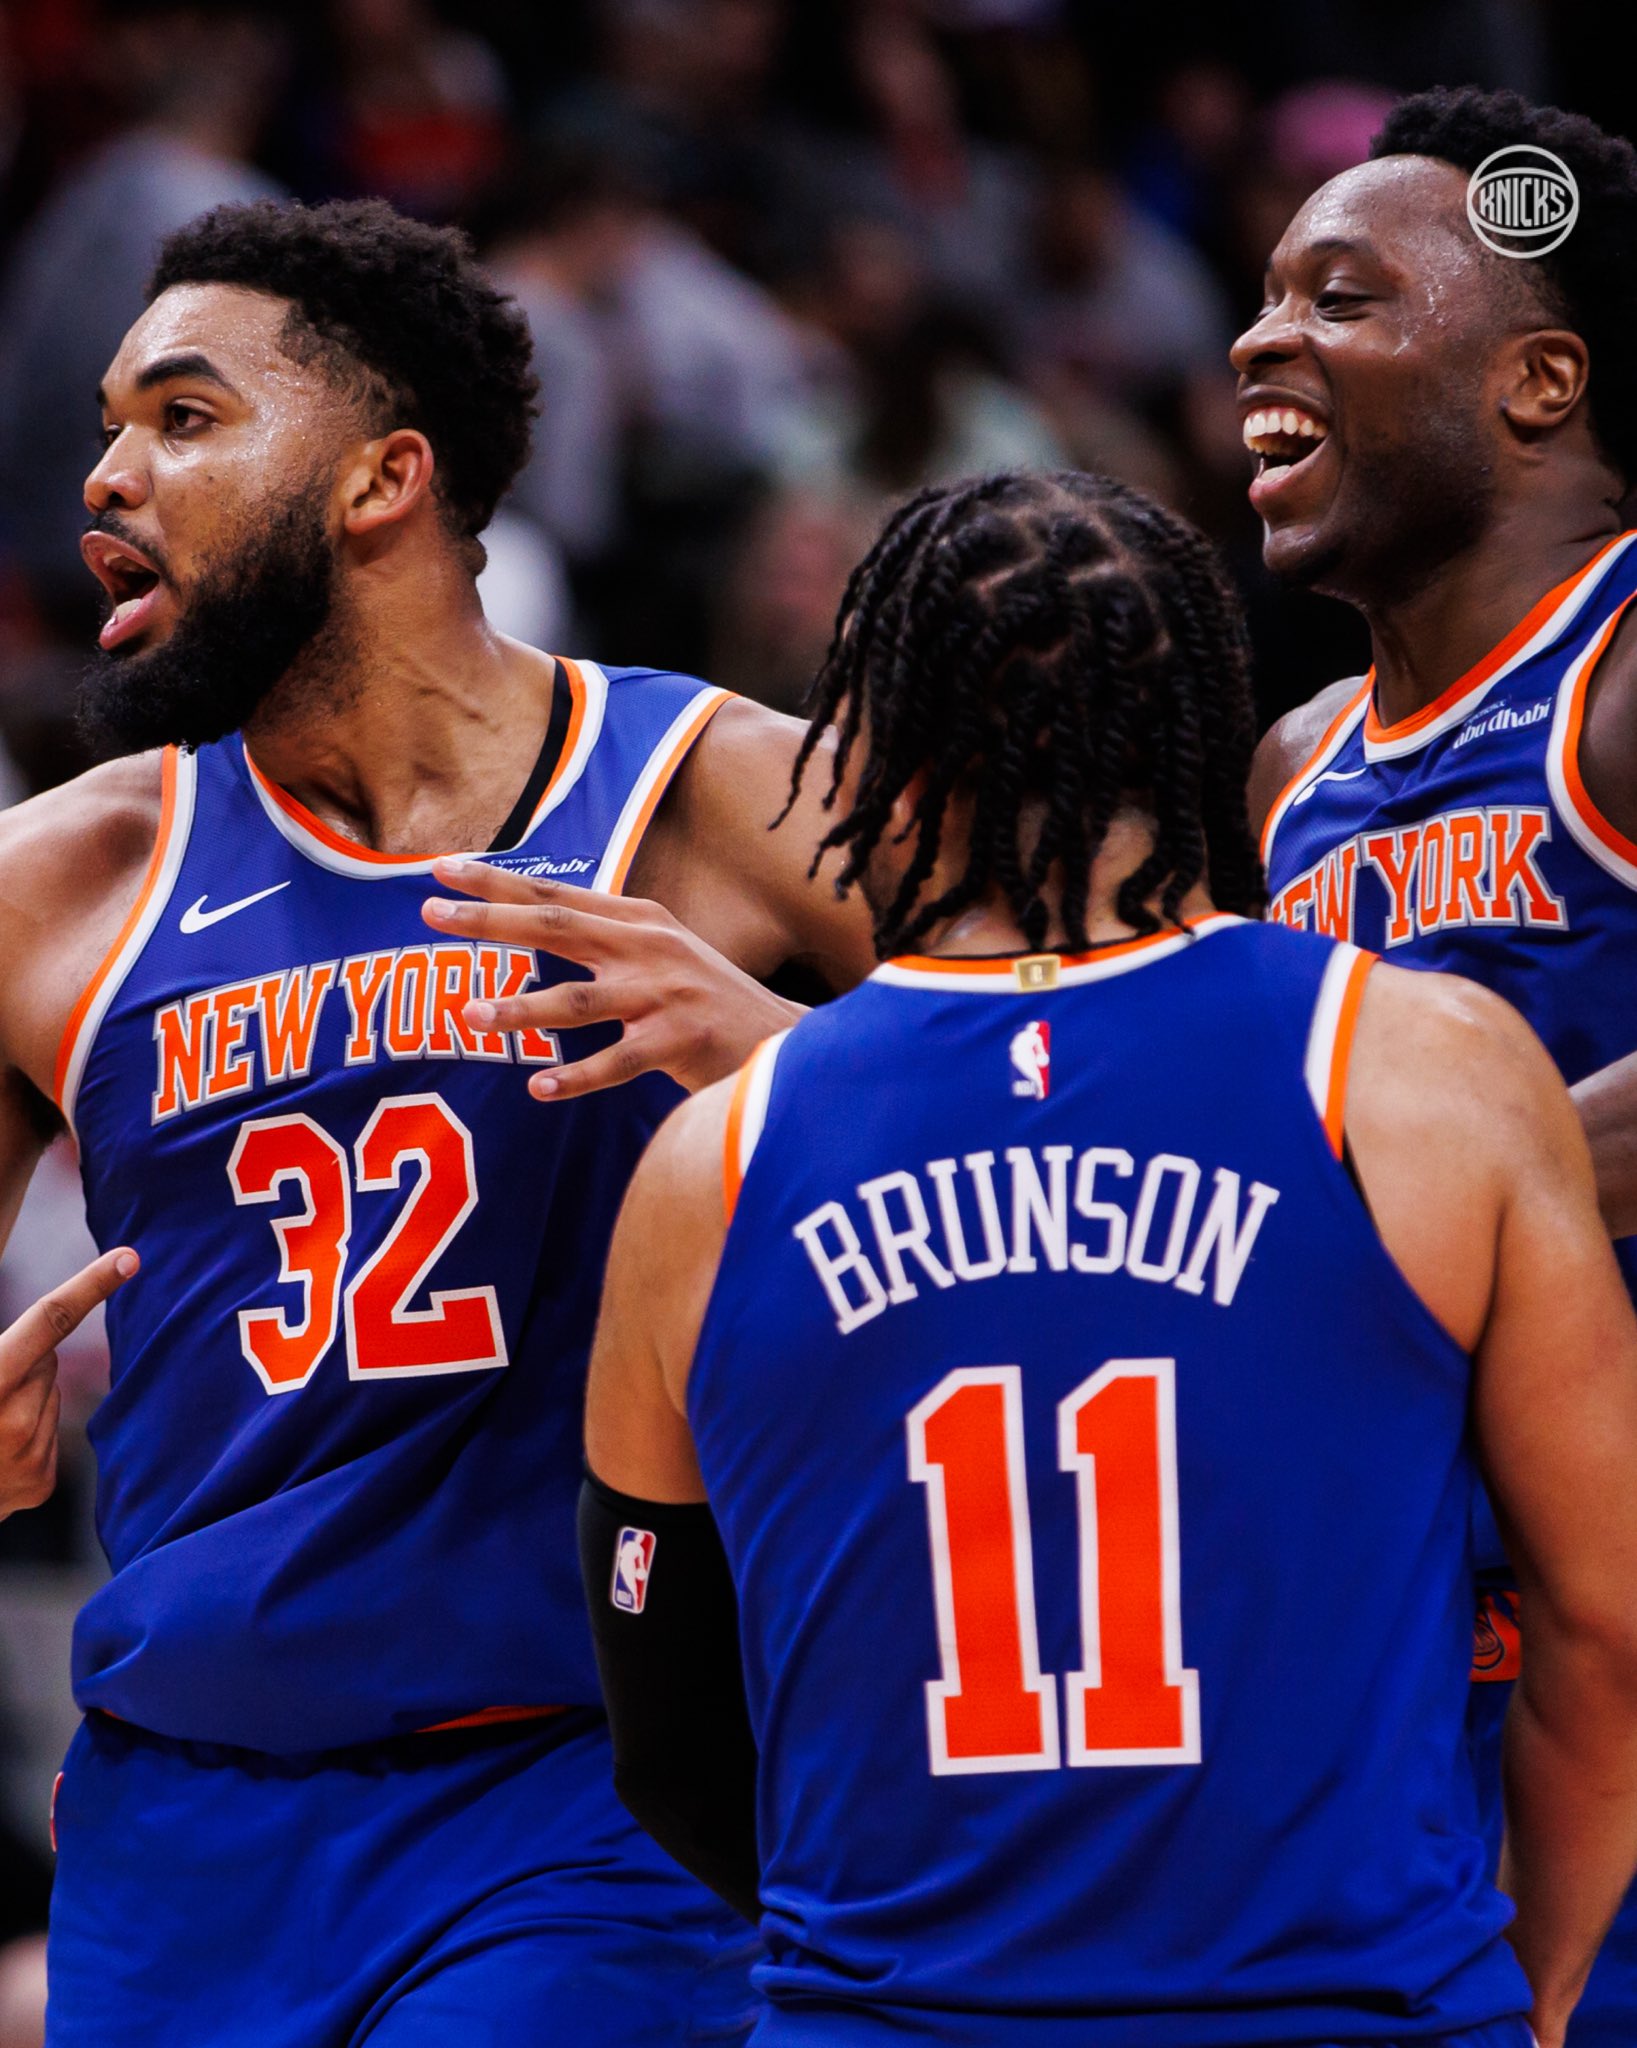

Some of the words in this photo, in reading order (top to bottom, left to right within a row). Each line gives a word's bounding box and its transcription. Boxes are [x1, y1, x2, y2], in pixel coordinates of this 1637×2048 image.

[1453, 721, 1486, 749] abu
[1487, 697, 1552, 732] dhabi
[522, 858, 596, 876] dhabi
[1357, 805, 1569, 949] YORK
[151, 958, 340, 1126] NEW
[227, 1092, 509, 1395] 32
[793, 1145, 1280, 1335] BRUNSON
[905, 1357, 1202, 1776] 11
